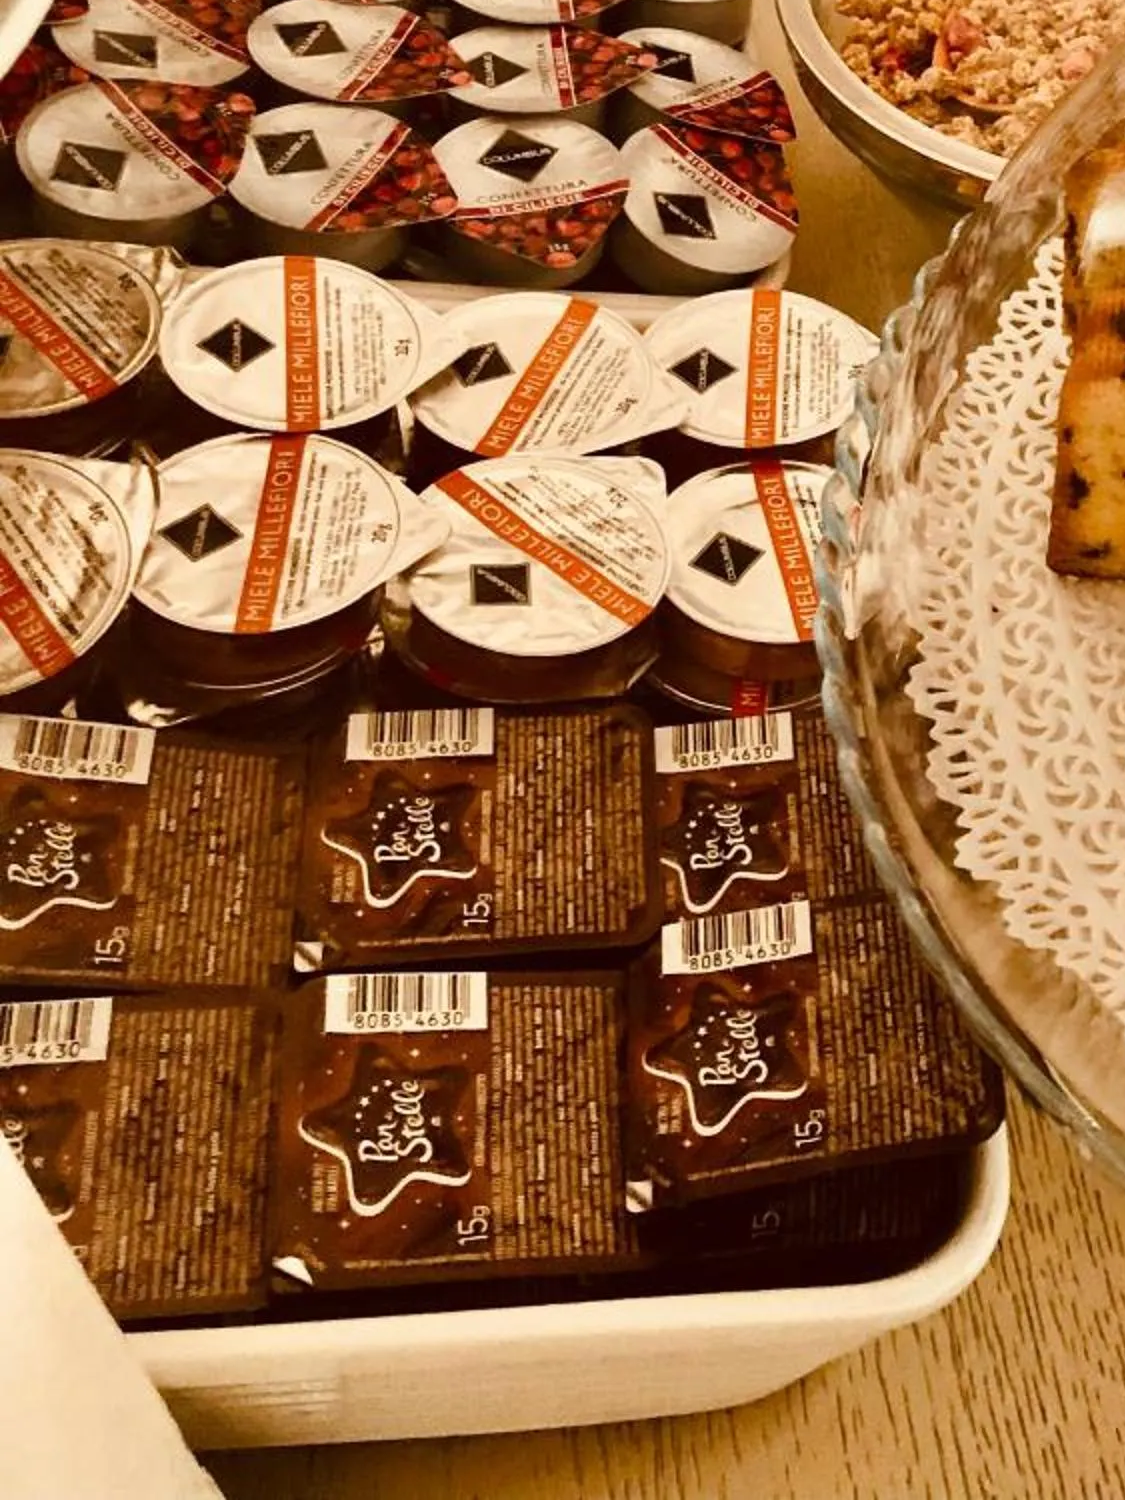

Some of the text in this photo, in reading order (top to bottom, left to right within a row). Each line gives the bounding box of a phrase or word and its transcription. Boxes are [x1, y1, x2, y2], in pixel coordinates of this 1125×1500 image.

[482, 147, 553, 167] COLUMBUS
[476, 179, 589, 204] CONFETTURA
[54, 344, 101, 397] MIELE
[289, 274, 314, 425] MIELE MILLEFIORI
[487, 403, 528, 448] MIELE
[522, 317, 585, 401] MILLEFIORI
[751, 306, 776, 440] MIELE MILLEFIORI
[244, 451, 297, 621] MIELE MILLEFIORI
[462, 489, 573, 573] MILLEFIORI
[763, 476, 804, 569] MILLEFIORI
[573, 569, 638, 616] MIELE
[792, 575, 819, 629] MIELE
[5, 599, 59, 663] MIELE
[19, 755, 129, 779] 8085 4630
[372, 739, 473, 757] 8085 4630
[678, 745, 774, 769] 8085 4630
[373, 826, 410, 862] Pan
[406, 797, 441, 862] Stelle
[714, 802, 753, 866] Stelle
[7, 846, 48, 888] Pan
[43, 822, 81, 890] Stelle
[690, 835, 723, 871] Pan
[463, 892, 493, 927] 15g
[94, 925, 130, 965] 15g
[690, 943, 792, 970] 8085 4630
[353, 1011, 465, 1029] 8085 4630
[27, 1041, 81, 1060] 4630
[726, 1008, 769, 1083] Stelle
[699, 1047, 737, 1088] Pan
[357, 1120, 399, 1163] Pan
[391, 1080, 433, 1163] Stelle
[795, 1108, 827, 1148] 15g
[457, 1204, 491, 1246] 15g
